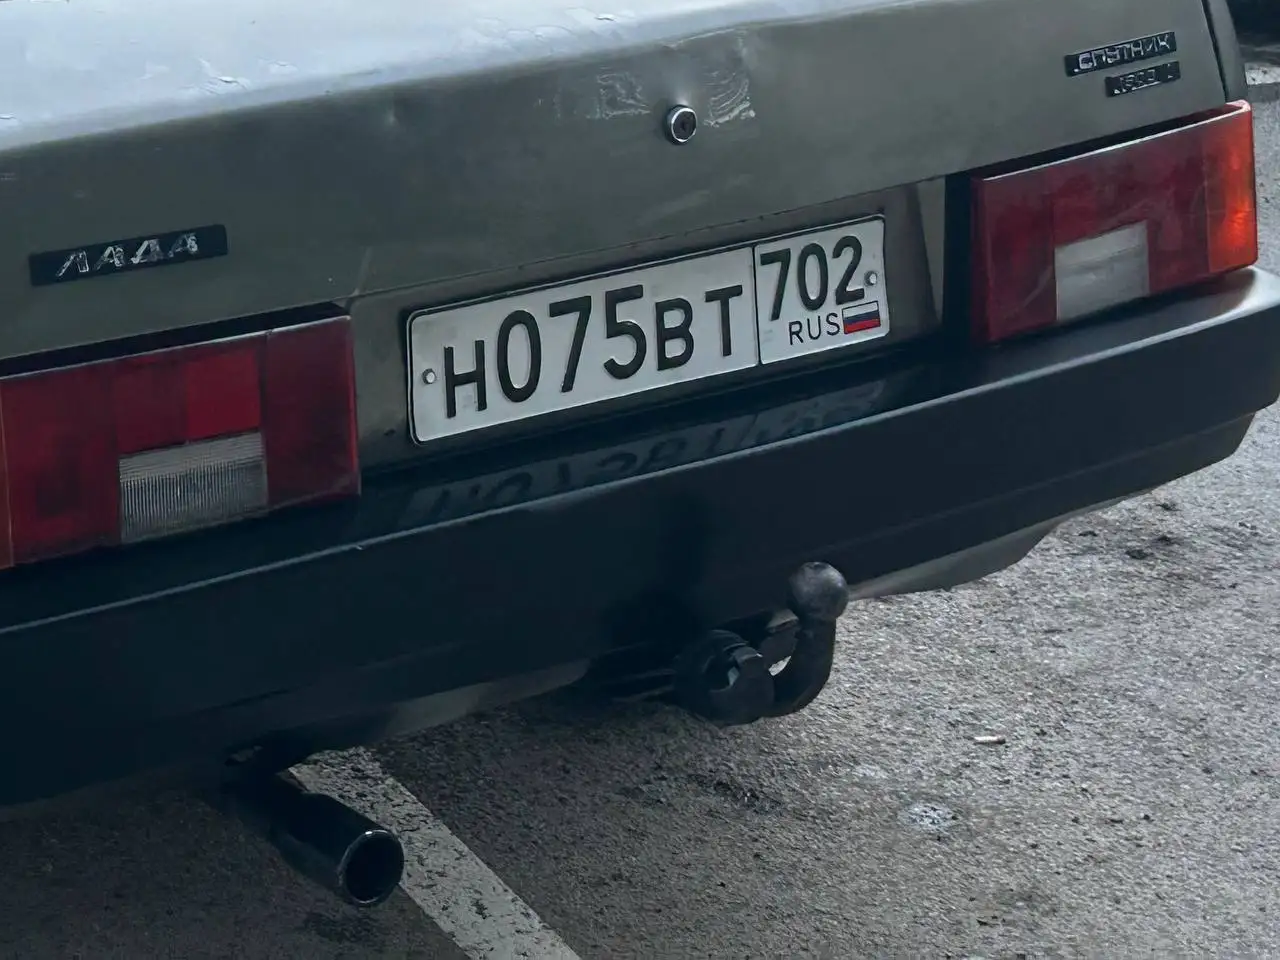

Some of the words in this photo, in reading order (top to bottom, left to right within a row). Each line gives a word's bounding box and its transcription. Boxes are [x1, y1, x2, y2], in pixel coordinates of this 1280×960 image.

[1078, 33, 1171, 70] СПУТНИК
[55, 232, 199, 278] ЛАДА
[760, 235, 865, 321] 702
[789, 312, 841, 345] RUS
